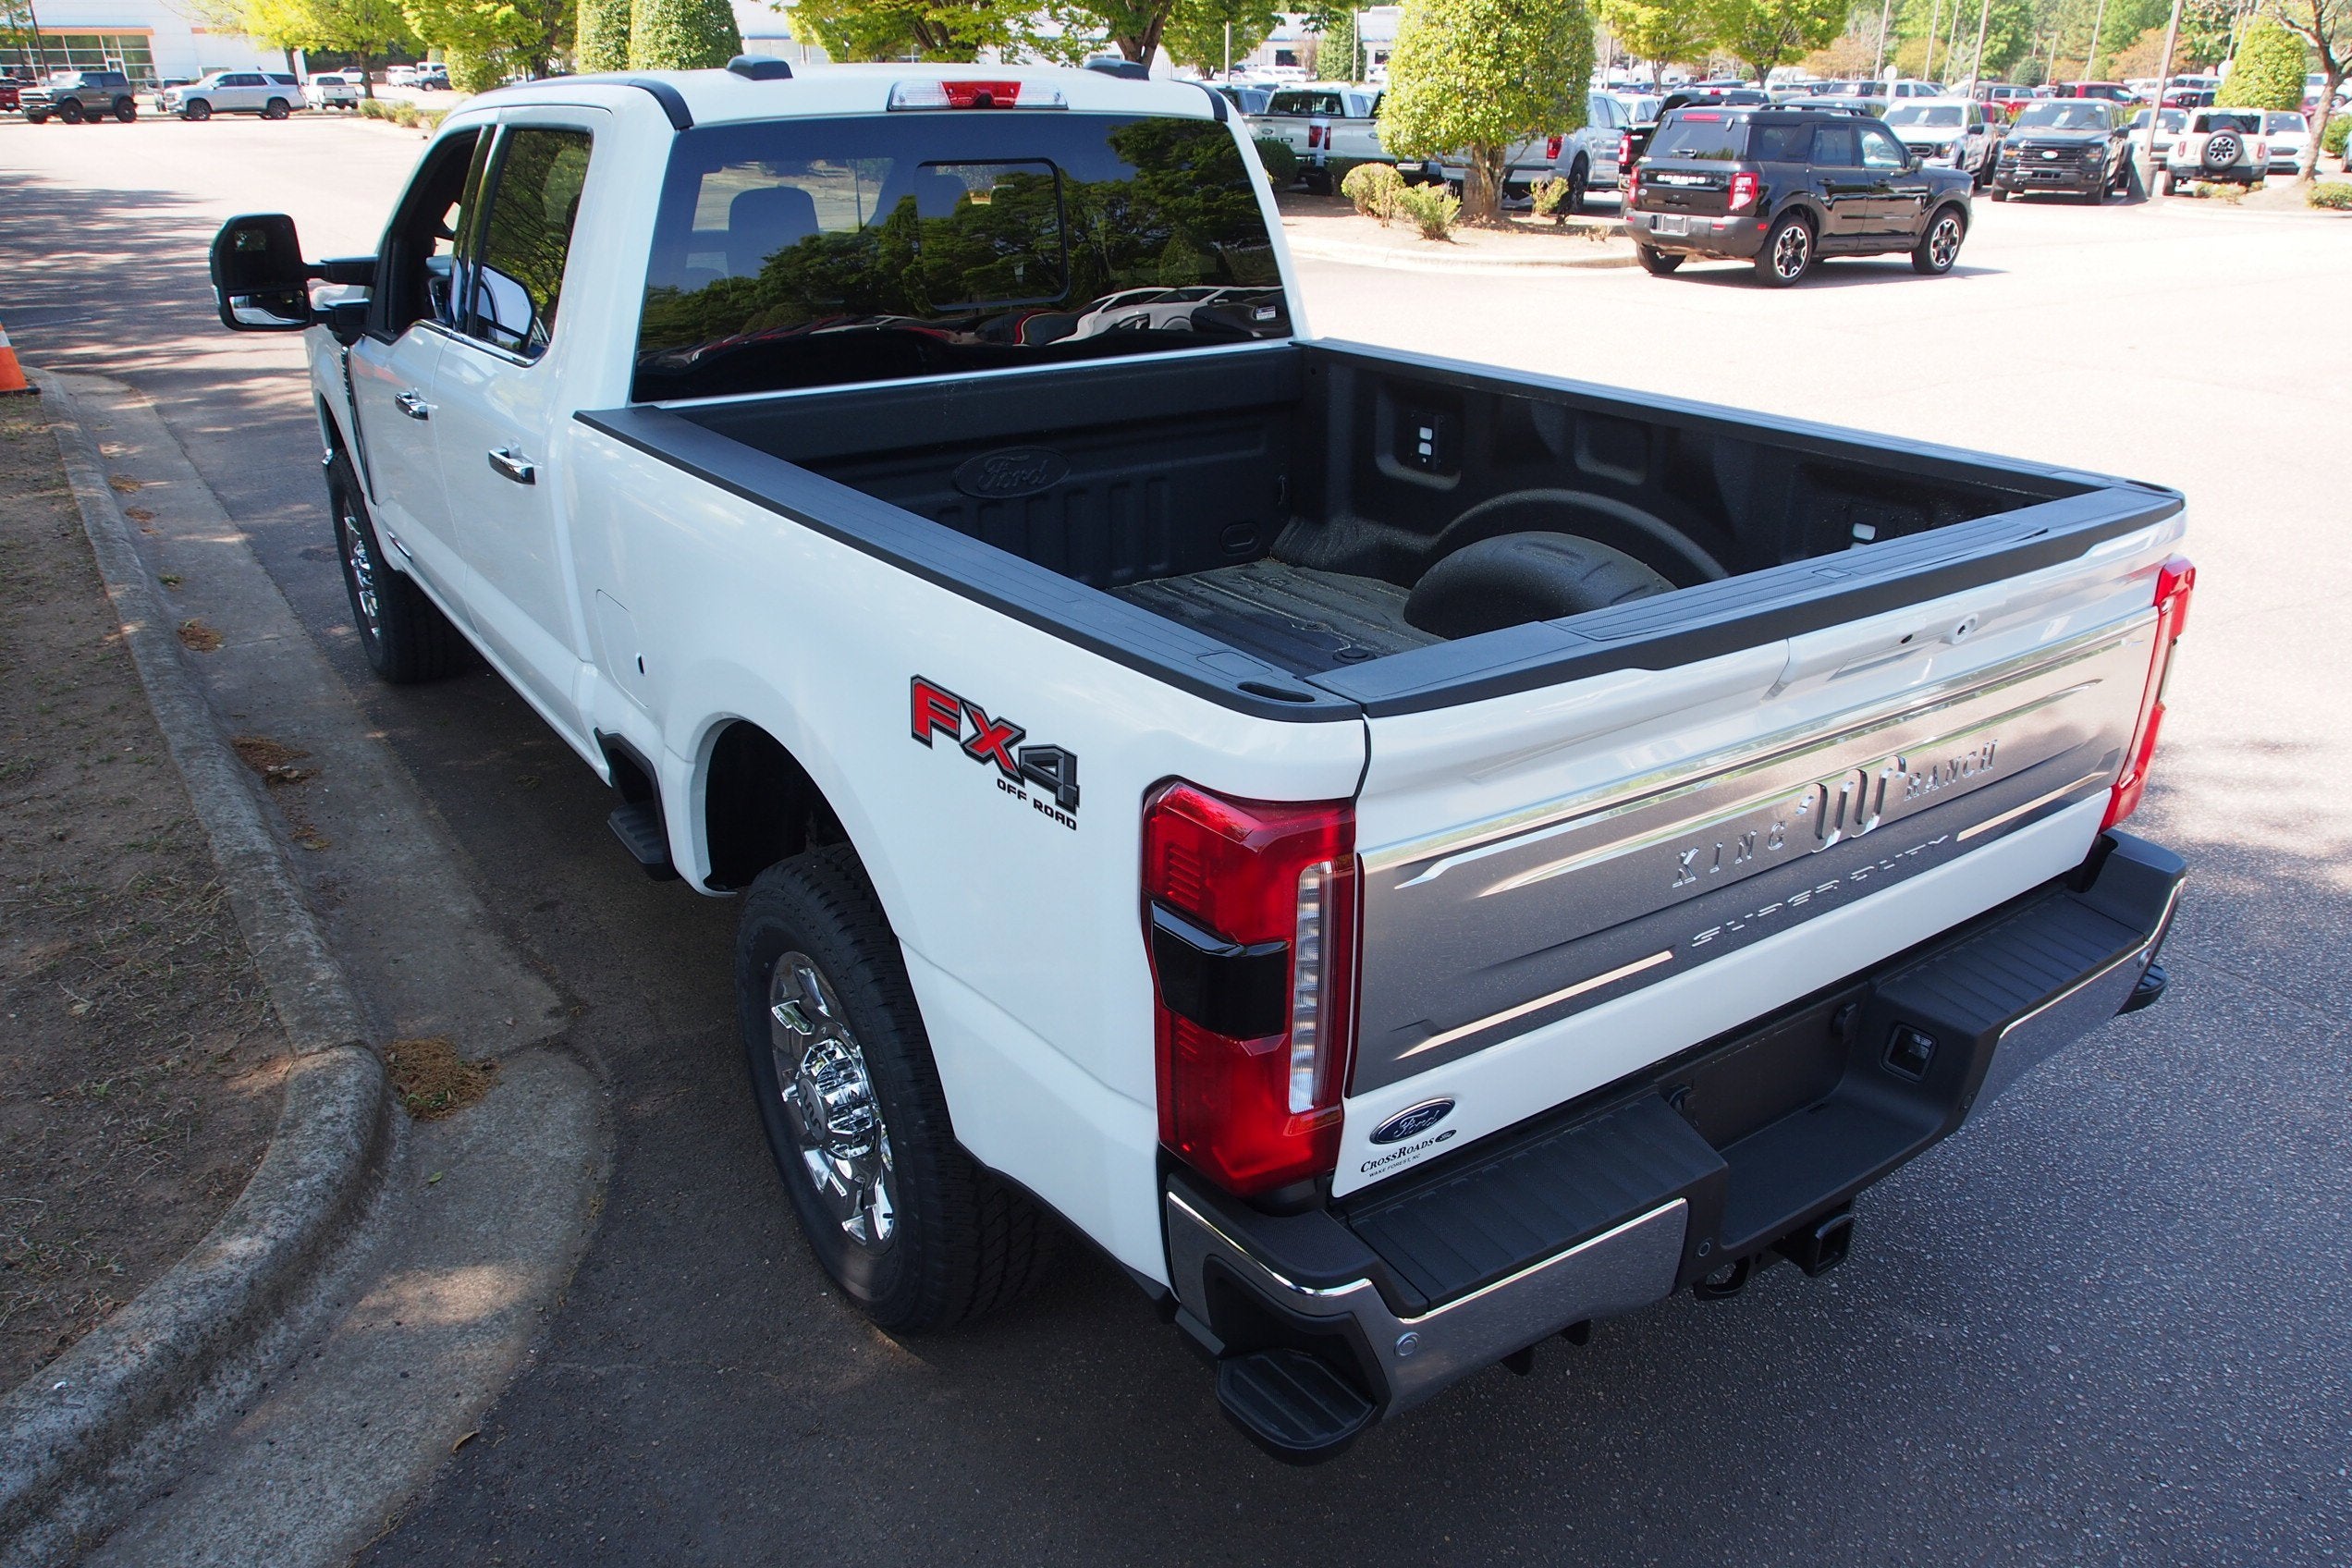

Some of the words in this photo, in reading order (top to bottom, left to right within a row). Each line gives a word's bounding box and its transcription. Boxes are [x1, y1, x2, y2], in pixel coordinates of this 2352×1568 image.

[977, 454, 1048, 492] Ford
[911, 674, 1080, 816] FX4
[997, 778, 1027, 802] OFF
[1033, 798, 1077, 831] ROAD
[1672, 820, 1786, 888] KING
[1903, 739, 1998, 802] RANCH
[1691, 879, 1840, 949] SUPER
[1850, 834, 1949, 882] DUTY
[1393, 1109, 1440, 1138] Ford
[1368, 1168, 1386, 1178] WAKE
